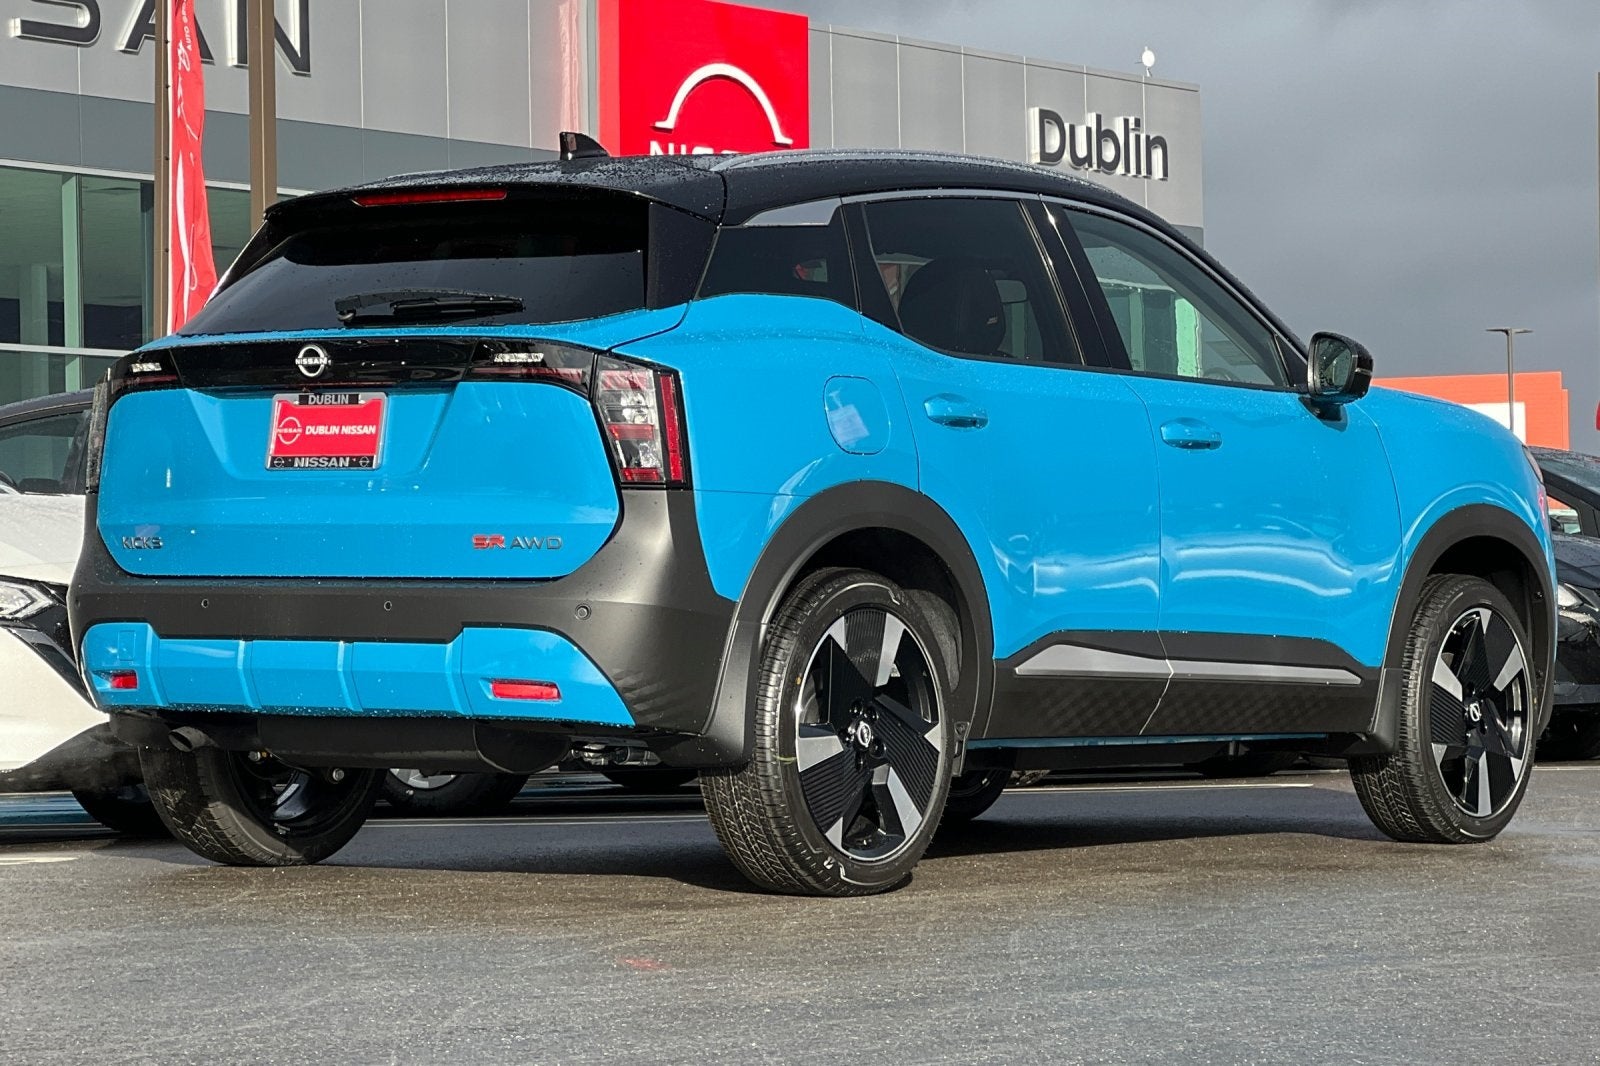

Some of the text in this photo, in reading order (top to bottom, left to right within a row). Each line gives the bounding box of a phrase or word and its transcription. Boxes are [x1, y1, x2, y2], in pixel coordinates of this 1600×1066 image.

[184, 26, 193, 51] AUTO
[1029, 107, 1168, 181] Dublin
[295, 357, 328, 365] NISSAN
[308, 394, 349, 405] DUBLIN
[305, 425, 377, 435] DUBLIN NISSAN
[293, 456, 350, 468] NISSAN
[122, 536, 163, 549] KICKS
[472, 534, 563, 550] SR AWD
